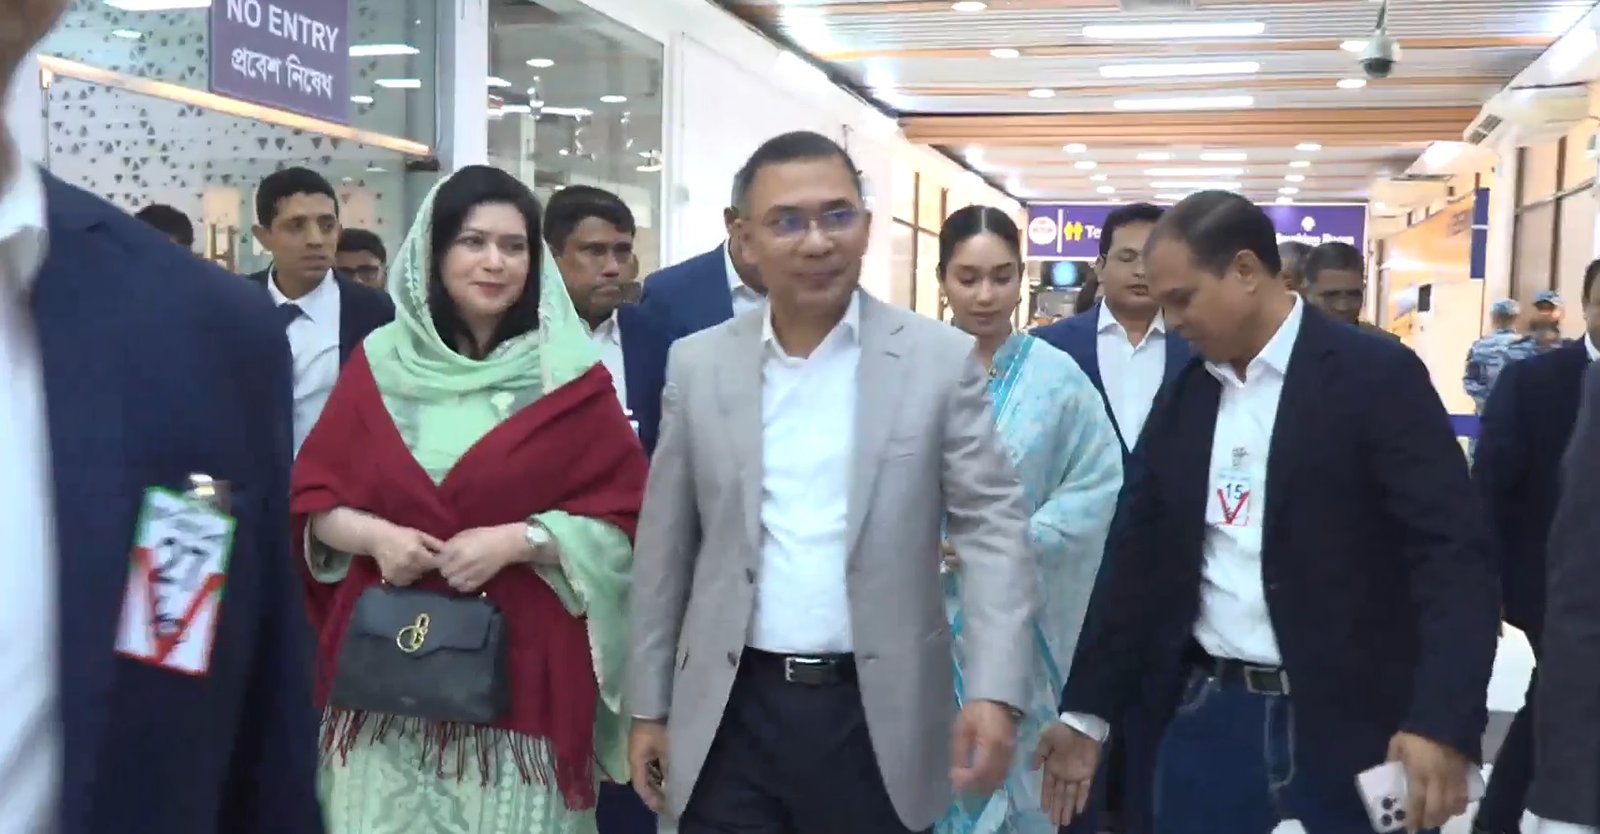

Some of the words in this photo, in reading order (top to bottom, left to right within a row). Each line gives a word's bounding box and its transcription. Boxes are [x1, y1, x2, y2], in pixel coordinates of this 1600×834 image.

[226, 0, 262, 28] NO
[268, 4, 339, 53] ENTRY
[231, 47, 281, 85] প্রবেশ
[1226, 483, 1244, 500] 15
[148, 536, 210, 592] 27
